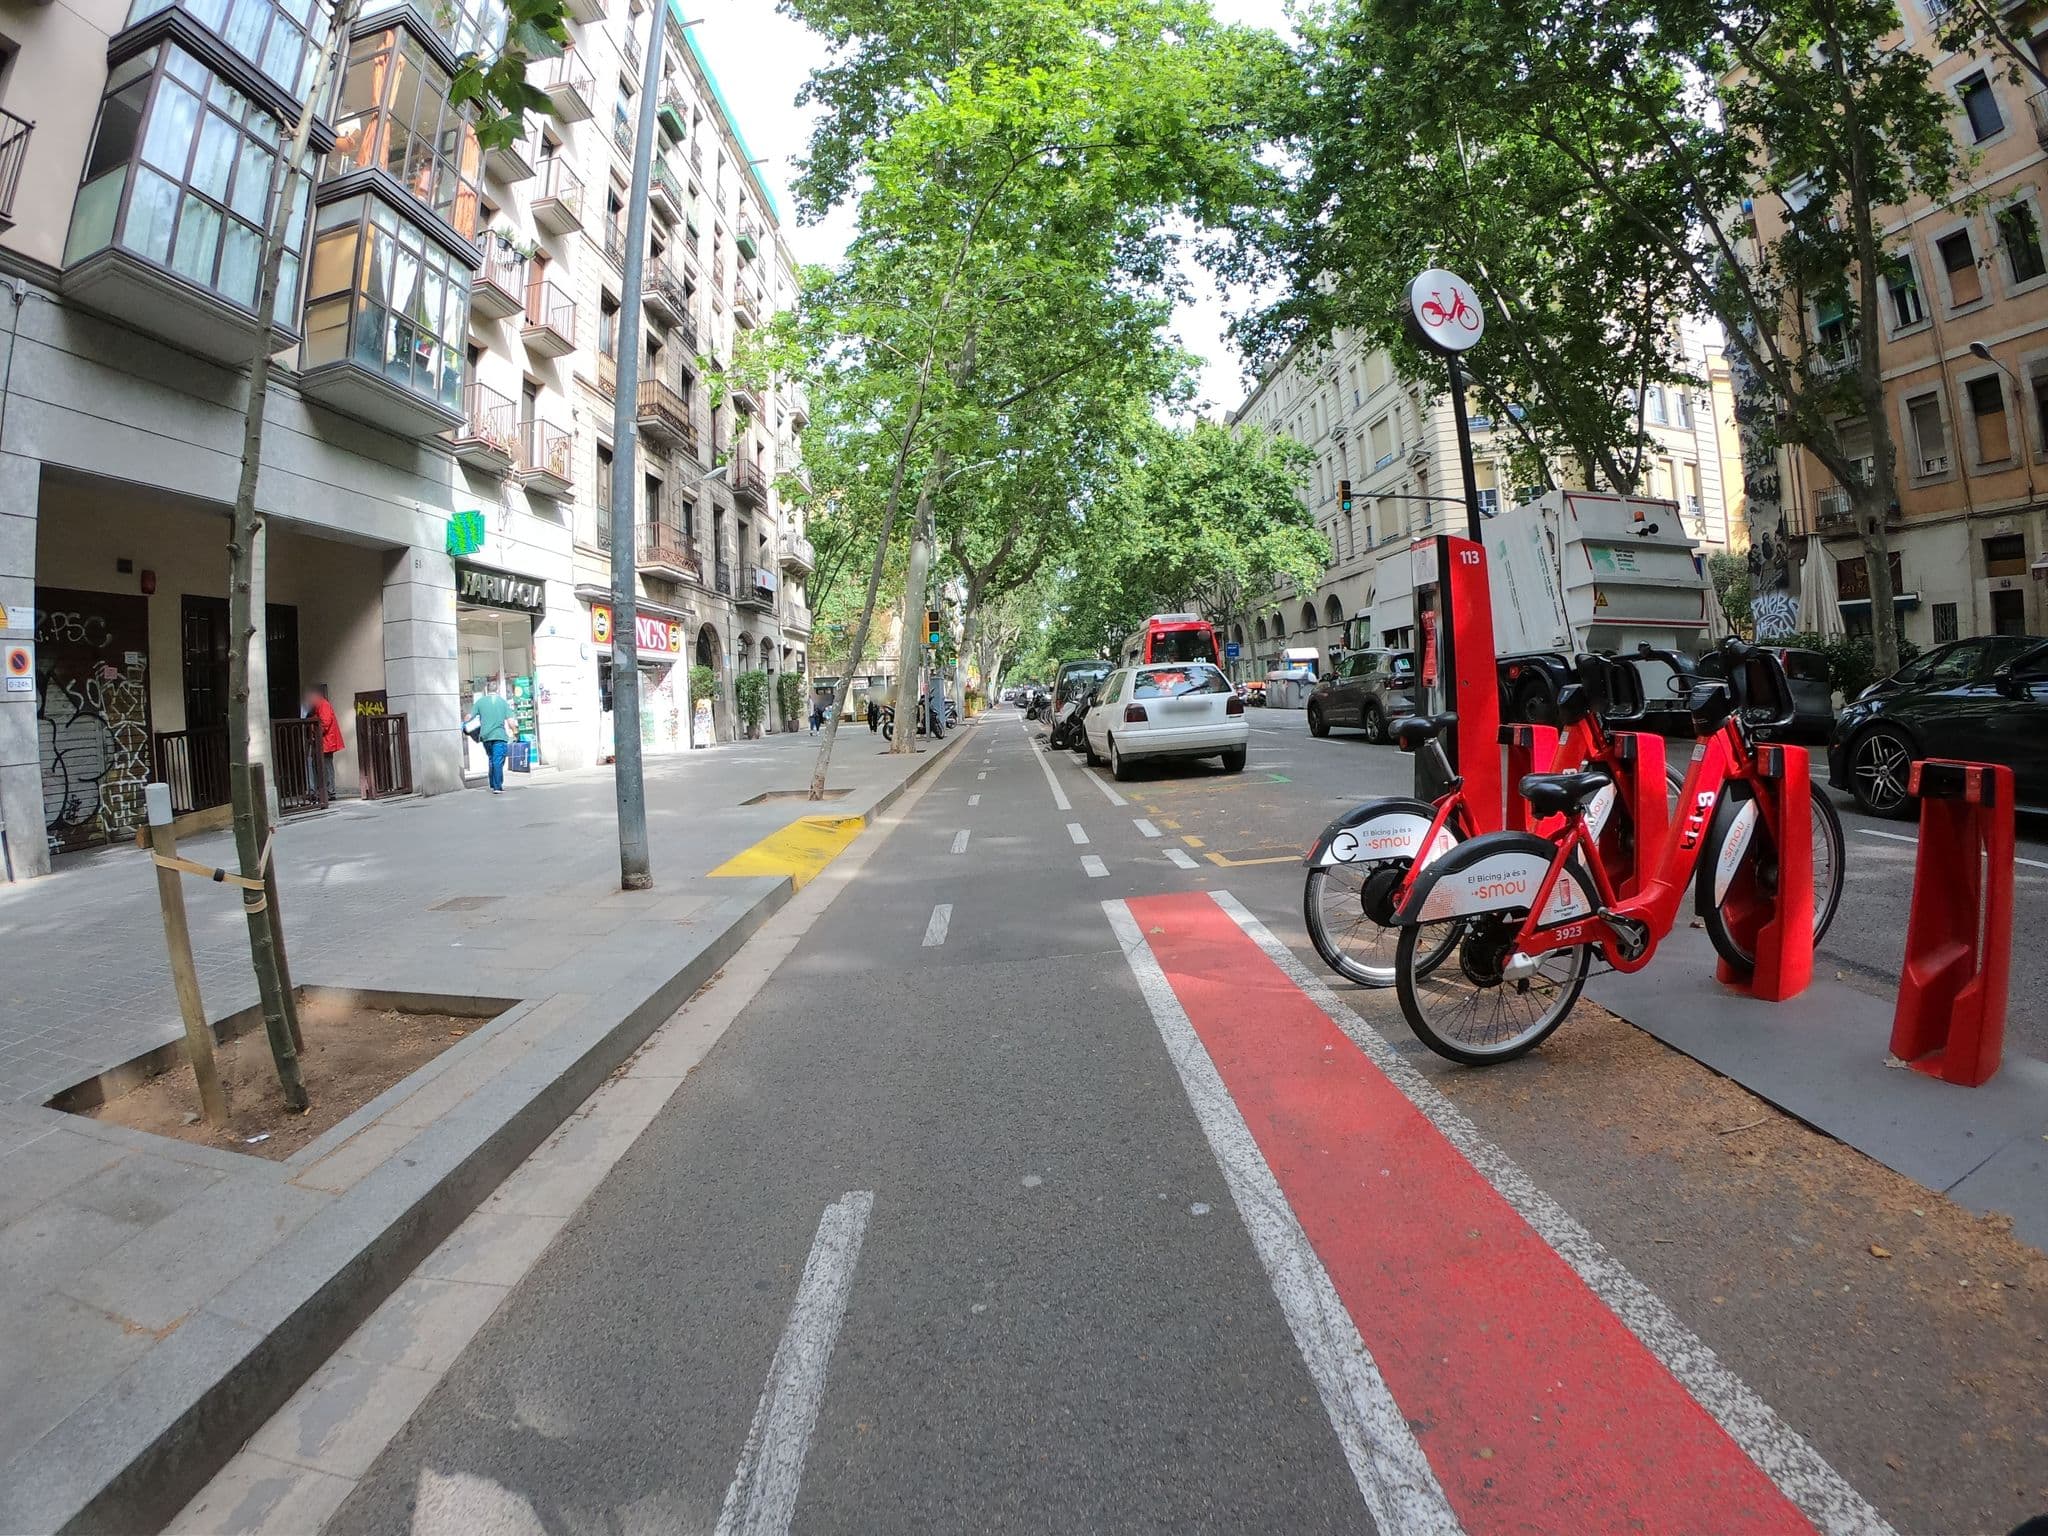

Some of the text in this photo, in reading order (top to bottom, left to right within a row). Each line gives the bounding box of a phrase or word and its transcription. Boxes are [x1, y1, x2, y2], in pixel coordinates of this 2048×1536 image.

[1460, 551, 1480, 565] 113
[636, 616, 667, 650] NG'S
[1371, 828, 1391, 837] Bicing
[1371, 836, 1411, 849] smou
[1477, 873, 1502, 882] Bicing
[1503, 872, 1511, 880] ja
[1479, 880, 1527, 898] smou
[1556, 926, 1582, 940] 3923
